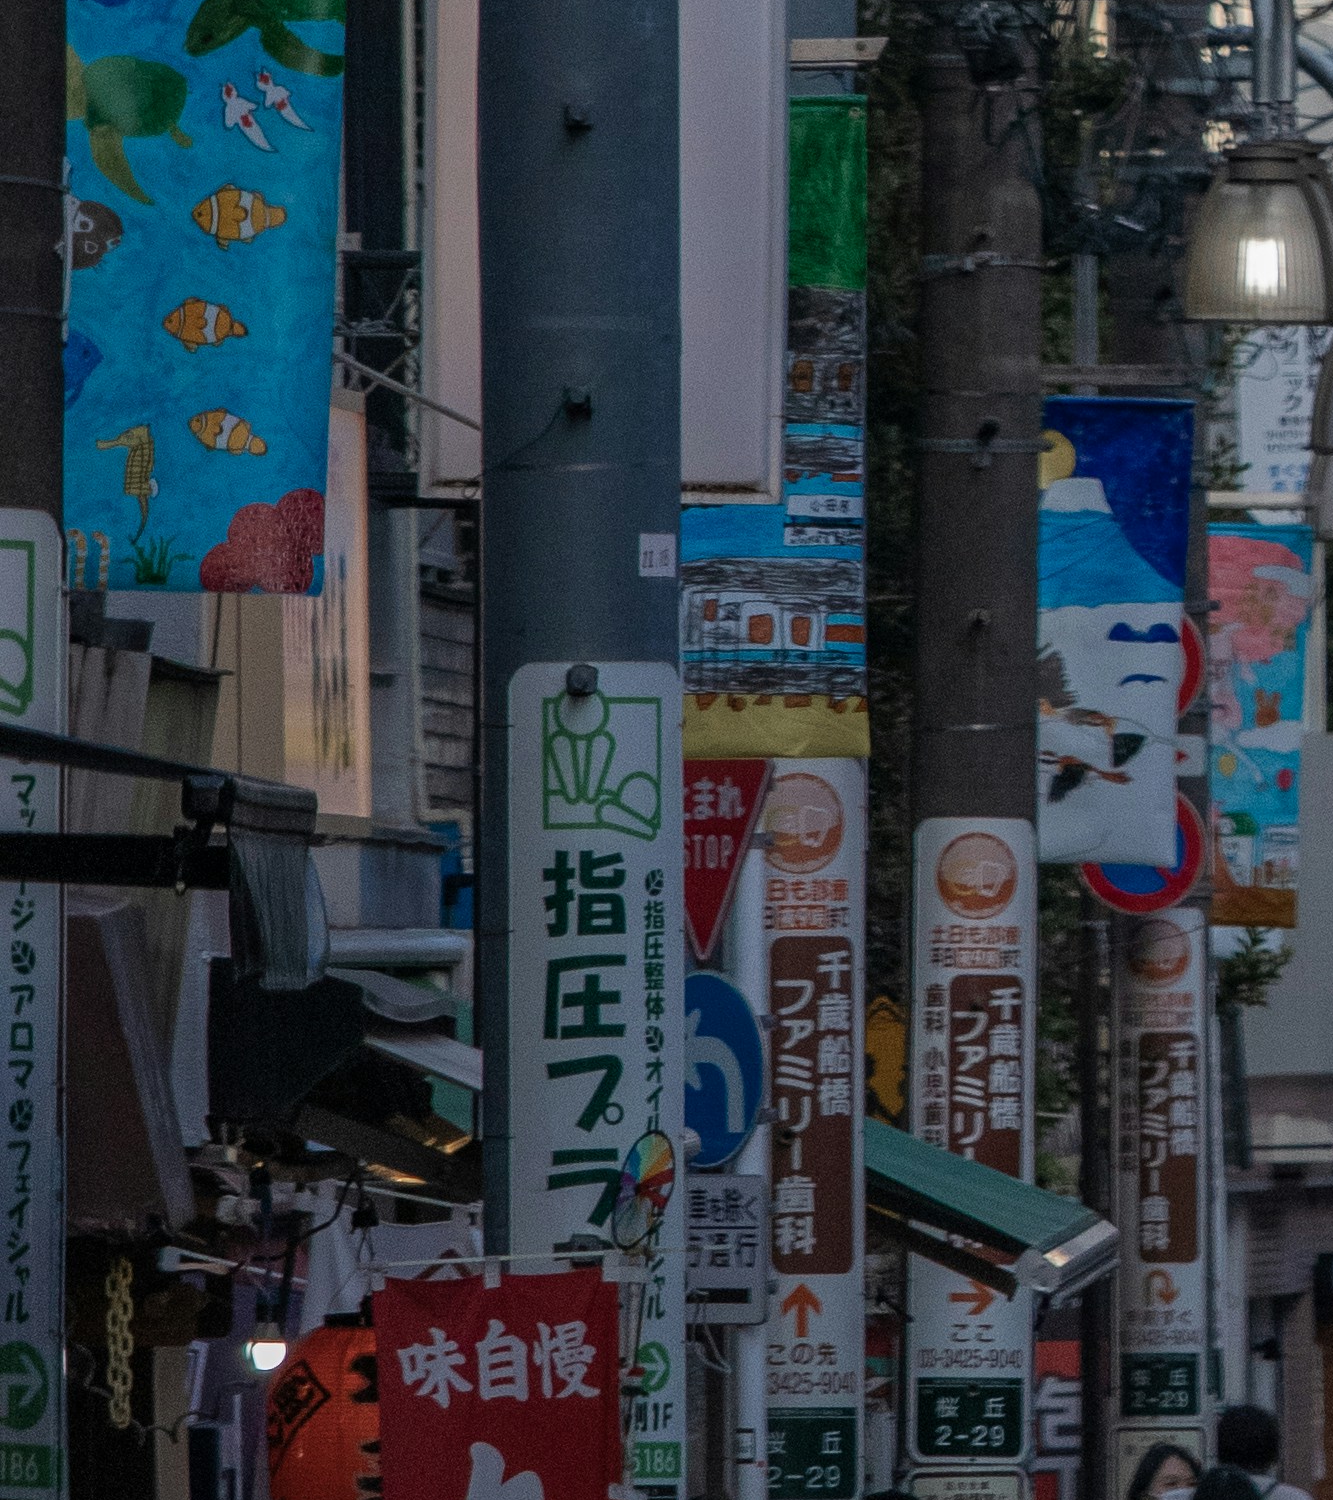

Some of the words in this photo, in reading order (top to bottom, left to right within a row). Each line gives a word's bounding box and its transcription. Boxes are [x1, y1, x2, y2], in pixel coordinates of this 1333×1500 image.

[951, 1323, 994, 1343] ここ
[395, 1318, 602, 1409] 味自慢
[933, 1424, 1006, 1448] 2-29
